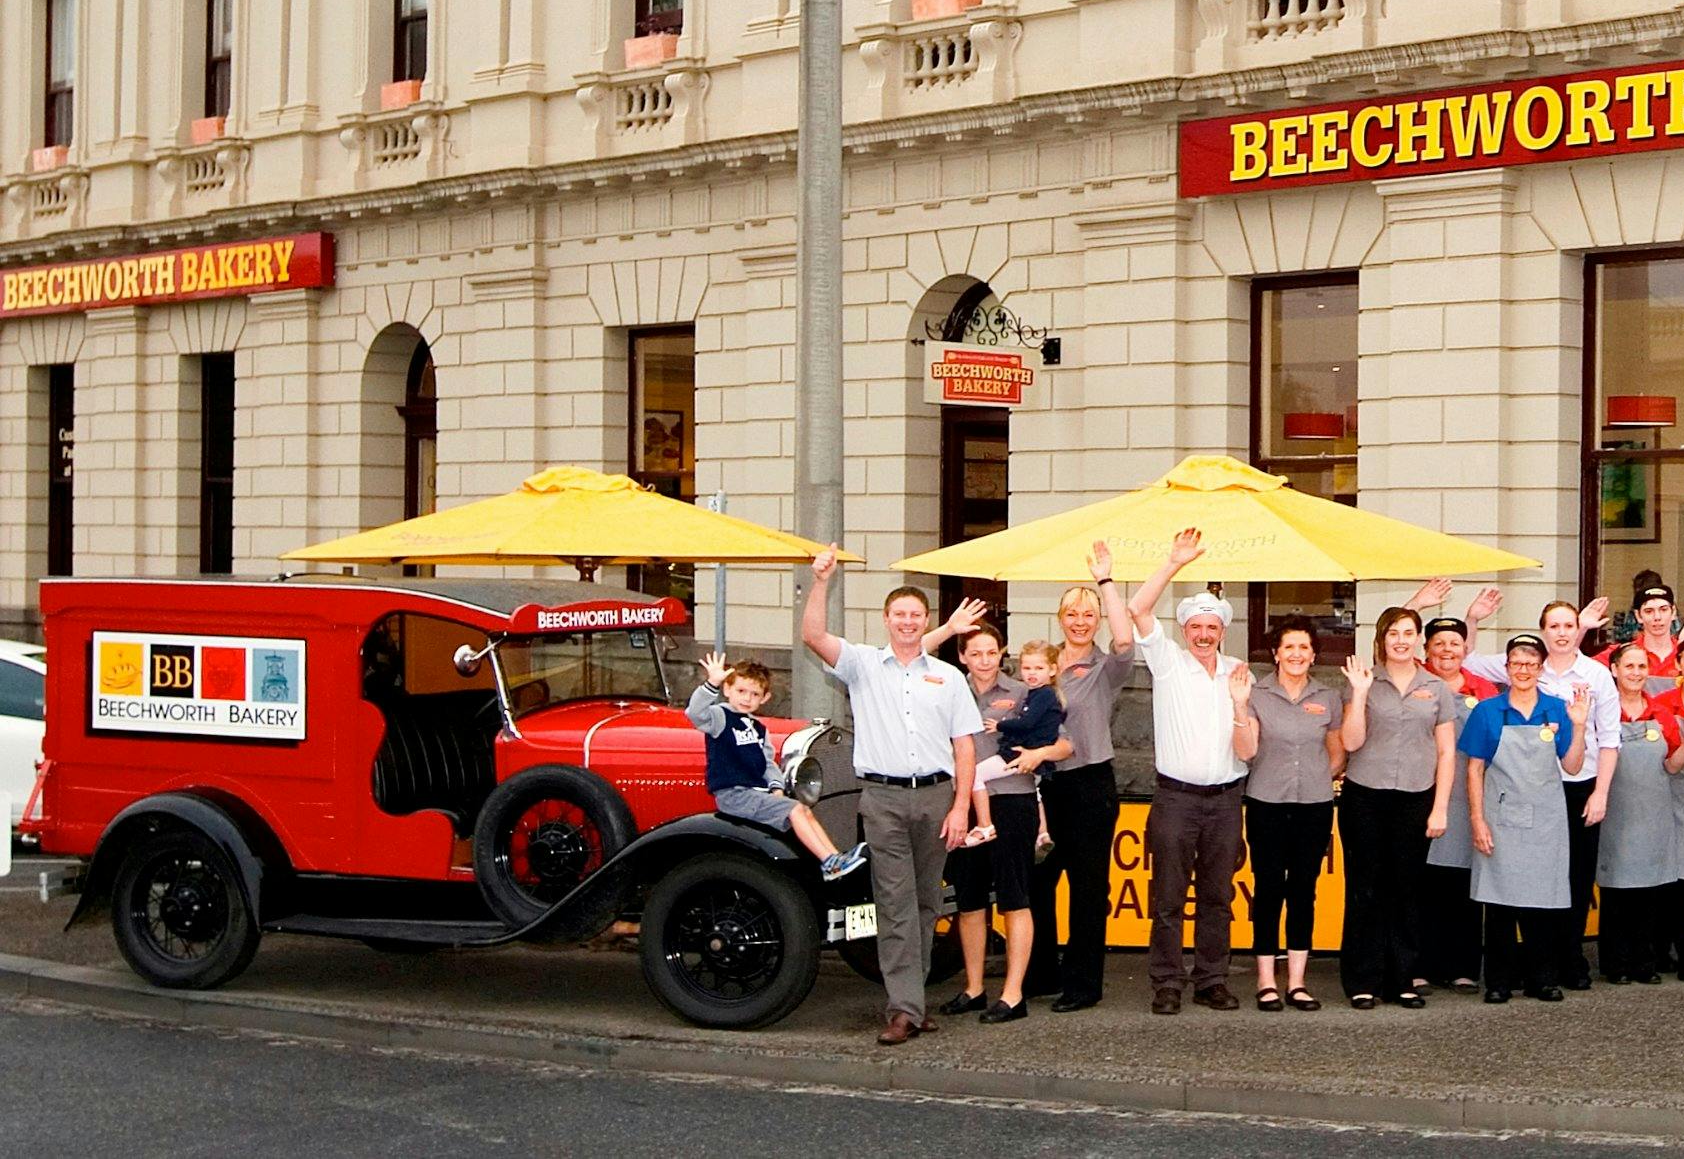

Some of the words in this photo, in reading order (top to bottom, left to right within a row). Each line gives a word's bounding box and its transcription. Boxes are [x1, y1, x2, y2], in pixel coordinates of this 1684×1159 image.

[2, 255, 175, 311] BEECHWORTH
[181, 240, 294, 292] BAKERY
[932, 363, 1033, 384] BEECHWORTH
[953, 378, 1012, 395] BAKERY
[538, 609, 618, 629] BEECHWORTH
[621, 607, 666, 625] BAKERY
[152, 654, 193, 689] BB
[98, 698, 216, 722] BEECHWORTH
[229, 704, 298, 727] BAKERY
